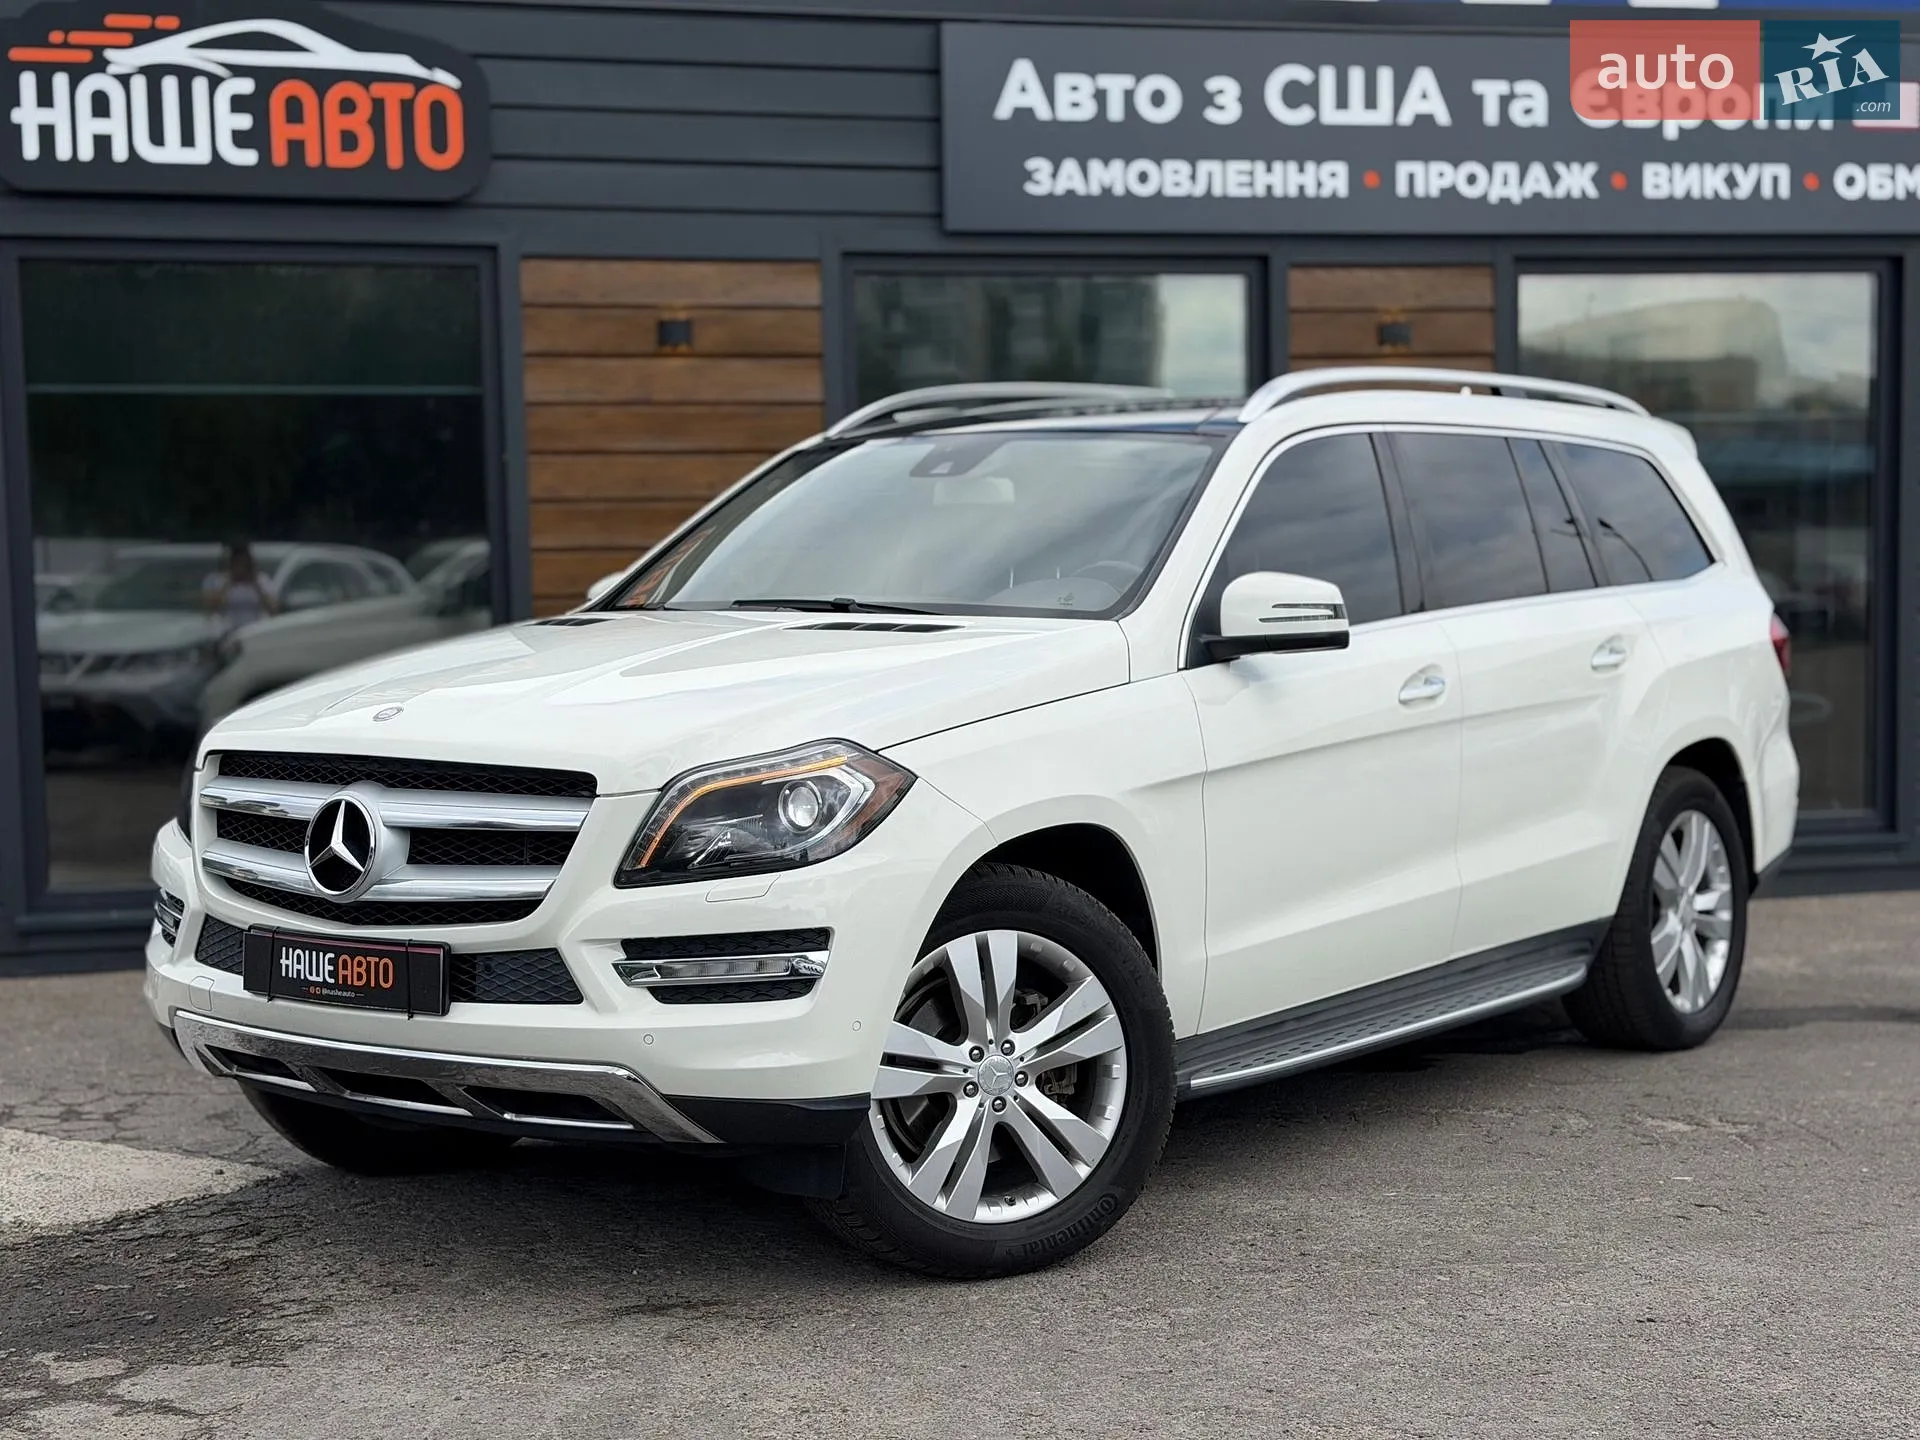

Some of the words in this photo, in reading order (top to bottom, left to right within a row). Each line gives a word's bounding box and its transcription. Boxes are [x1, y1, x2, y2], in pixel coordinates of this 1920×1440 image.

[10, 70, 259, 166] НАШЕ
[268, 79, 465, 171] АВТО
[993, 58, 1183, 124] Авто
[1203, 74, 1242, 126] з
[1263, 62, 1452, 127] США
[1472, 78, 1549, 127] та
[1023, 156, 1349, 198] ЗАМОВЛЕННЯ
[1396, 160, 1599, 204] ПРОДАЖ
[1642, 162, 1791, 201] ВИКУП
[279, 947, 335, 984] НАШЕ
[339, 955, 394, 989] АВТО
